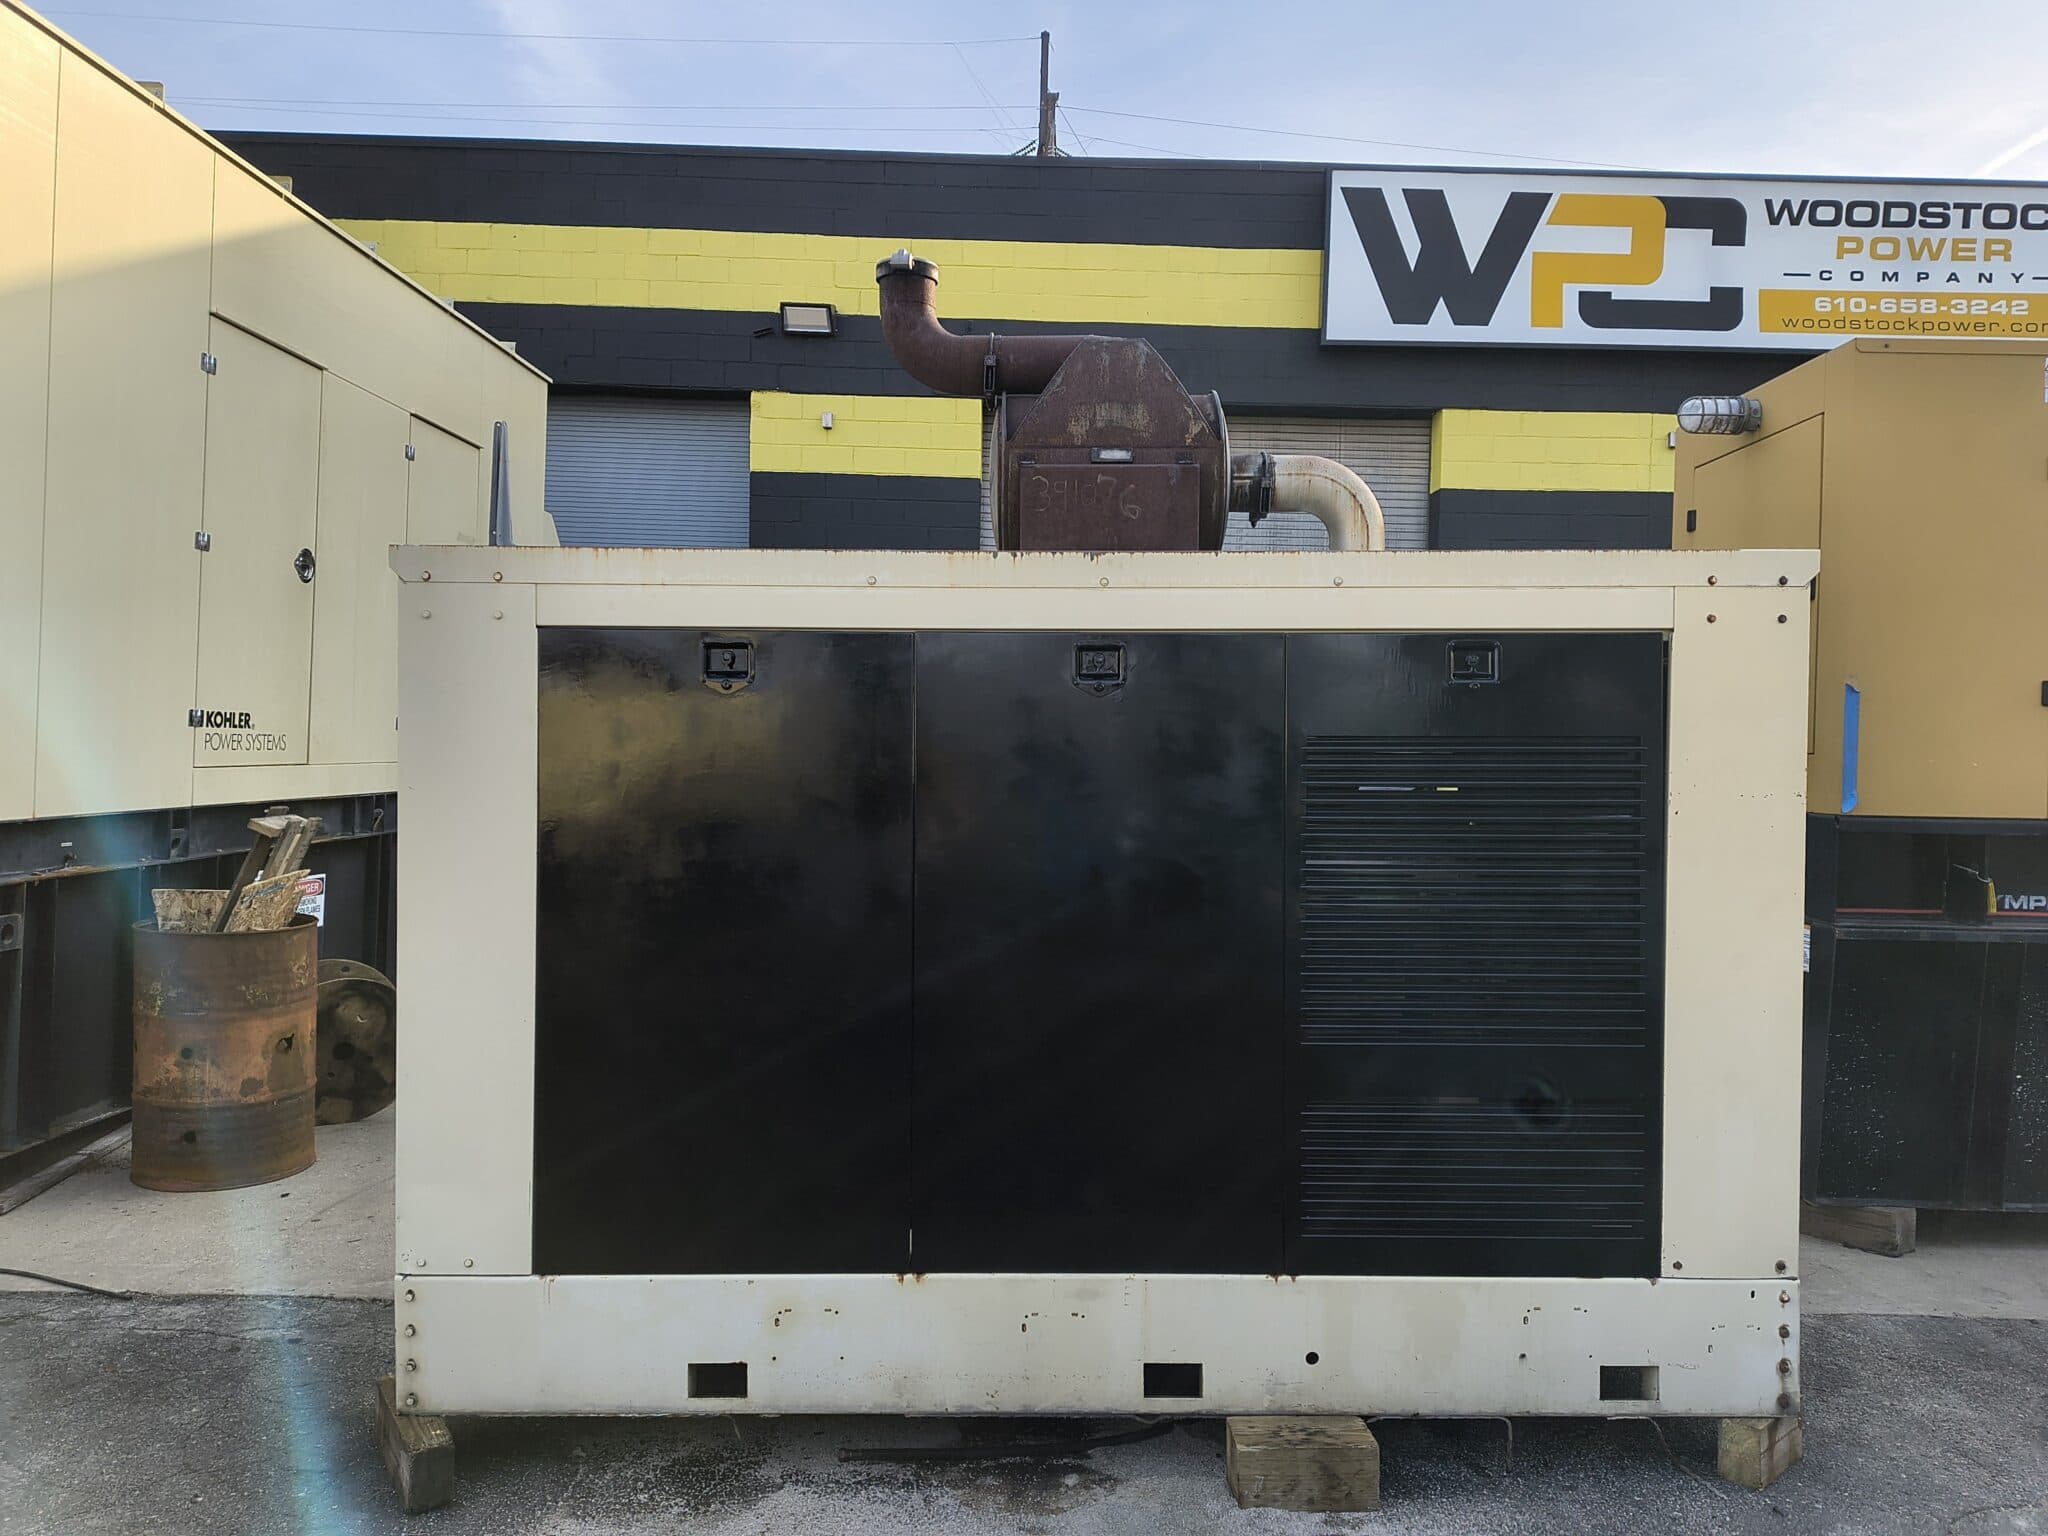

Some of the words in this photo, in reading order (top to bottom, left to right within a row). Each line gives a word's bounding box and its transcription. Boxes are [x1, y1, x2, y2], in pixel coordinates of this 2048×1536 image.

[1835, 235, 2013, 262] POWER
[1340, 186, 1748, 331] WPC
[1818, 269, 2025, 284] COMPANY
[1814, 296, 2029, 315] 610-658-3242
[205, 710, 252, 729] KOHLER
[204, 732, 243, 751] POWER
[245, 733, 288, 751] SYSTEMS
